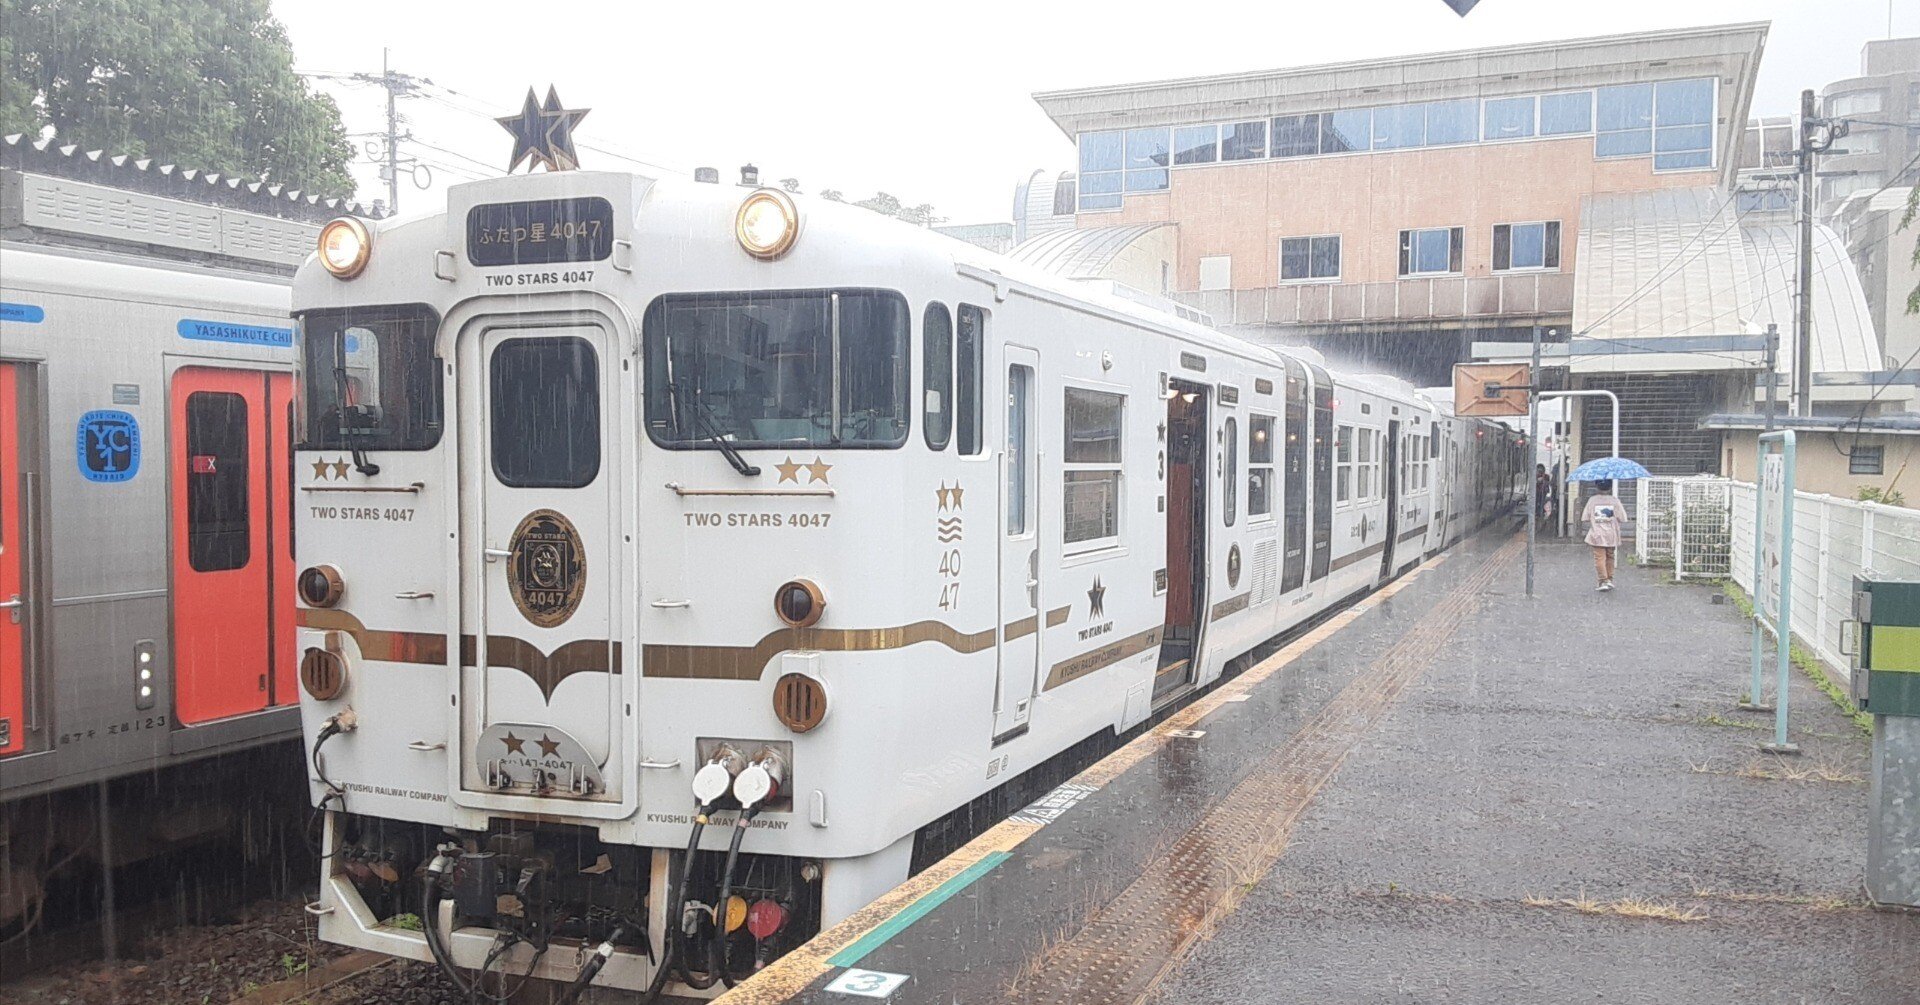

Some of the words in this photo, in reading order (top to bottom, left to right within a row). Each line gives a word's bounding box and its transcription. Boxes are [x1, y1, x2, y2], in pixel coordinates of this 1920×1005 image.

[485, 275, 513, 286] TWO
[517, 272, 559, 284] STARS
[562, 271, 595, 283] 4047
[195, 324, 269, 340] YASASHIKUTE
[310, 507, 337, 519] TWO
[341, 507, 380, 520] STARS
[384, 508, 415, 521] 4047
[684, 513, 722, 526] TWO
[727, 513, 783, 527] STARS
[787, 513, 831, 527] 4047
[938, 549, 961, 578] 40
[529, 592, 564, 606] 4047
[938, 582, 960, 612] 47
[1078, 629, 1088, 641] TWO
[342, 782, 374, 793] KYUSHU
[375, 786, 408, 797] RAILWAY
[409, 790, 448, 802] COMPANY
[647, 813, 688, 824] KYUSHU
[690, 815, 735, 827] RLWAY
[738, 819, 789, 830] OMPANY
[845, 973, 887, 992] 3
